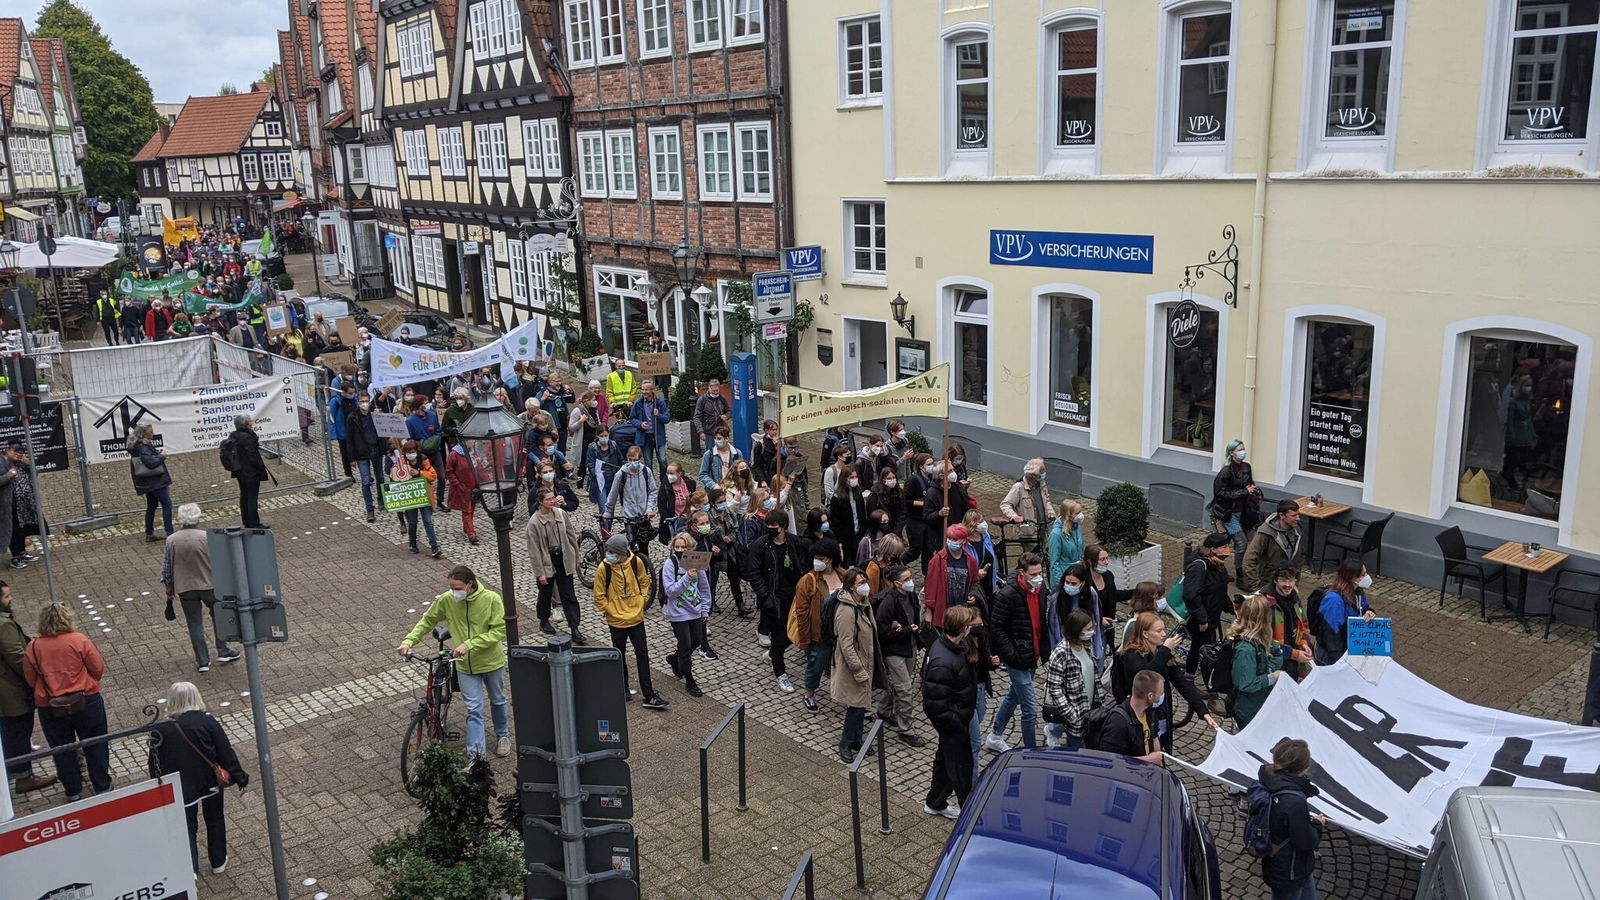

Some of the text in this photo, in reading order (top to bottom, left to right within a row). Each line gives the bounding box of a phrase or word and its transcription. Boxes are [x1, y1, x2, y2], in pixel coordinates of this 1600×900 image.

[1339, 107, 1368, 124] VPV
[1527, 107, 1564, 125] VPV
[1066, 120, 1087, 134] VPV
[1189, 115, 1214, 131] VPV
[963, 126, 980, 139] VPV
[995, 234, 1149, 261] VPV VERSICHERUNGEN
[790, 249, 812, 265] VPV
[819, 294, 829, 305] 42
[1171, 310, 1198, 338] Diele
[412, 361, 429, 371] FÜR
[199, 383, 248, 396] Zimmerei
[1055, 391, 1072, 400] FRISCH
[200, 391, 268, 405] Innenausbau
[786, 391, 803, 408] BI
[201, 403, 255, 415] Sanierung
[786, 414, 799, 423] Für
[800, 410, 822, 420] einen
[824, 397, 905, 415] ökologisch-sozialen
[1055, 400, 1077, 411] REGIONAL
[1055, 410, 1088, 422] HAUSGEMACHT
[1310, 408, 1352, 423] Ein guter Tag
[191, 425, 223, 433] Rakyweg
[1310, 420, 1344, 431] startet mit
[1309, 431, 1350, 444] einem Kaffee
[1321, 445, 1340, 454] endet
[1319, 455, 1339, 465] einem
[1340, 458, 1358, 469] Wein.
[385, 489, 427, 503] FUCK UP
[401, 497, 429, 506] CLIMATE
[1359, 631, 1386, 639] HOTTER
[23, 817, 81, 844] Celle
